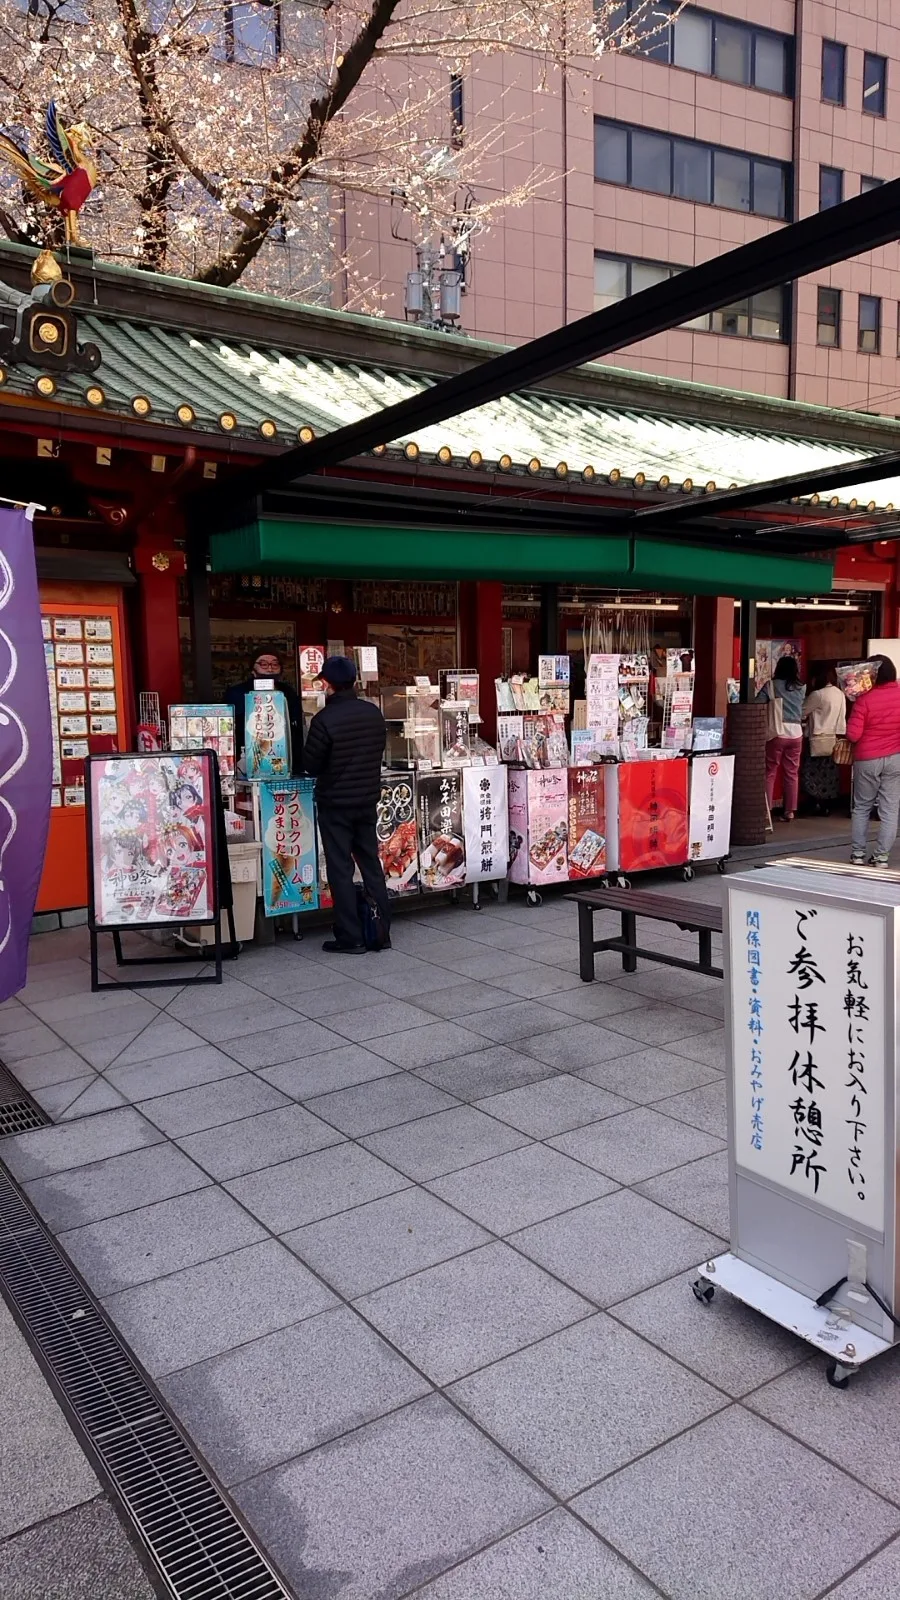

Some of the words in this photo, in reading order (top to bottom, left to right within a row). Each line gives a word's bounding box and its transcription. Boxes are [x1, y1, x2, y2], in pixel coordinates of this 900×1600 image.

[306, 650, 318, 674] 甘酒
[254, 695, 263, 739] 始めました
[265, 694, 276, 756] ソフトクリーム
[288, 790, 303, 884] ソフトクリーム
[109, 869, 157, 888] 神田祭
[746, 910, 764, 1152] 関係図書・資料・おみやげ売店
[786, 910, 826, 1194] ご参拝休憩所
[843, 932, 870, 1201] お気軽にお入り下さい。
